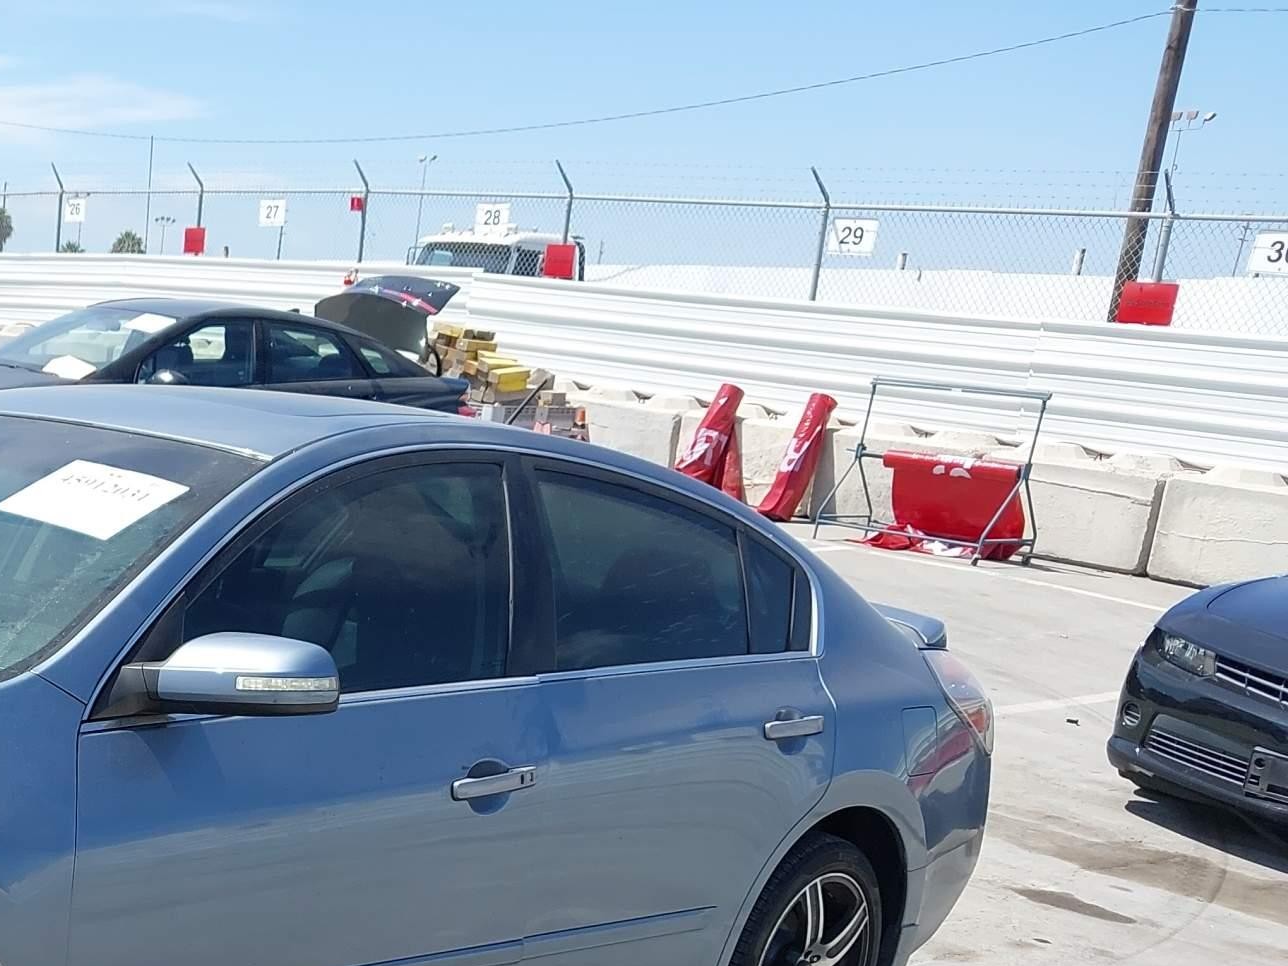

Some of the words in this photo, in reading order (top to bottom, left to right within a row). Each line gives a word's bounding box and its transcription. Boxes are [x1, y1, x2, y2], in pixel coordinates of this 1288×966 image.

[69, 204, 81, 216] 26
[265, 206, 279, 219] 27
[484, 209, 501, 226] 28
[838, 226, 864, 246] 29
[1266, 240, 1288, 264] 3
